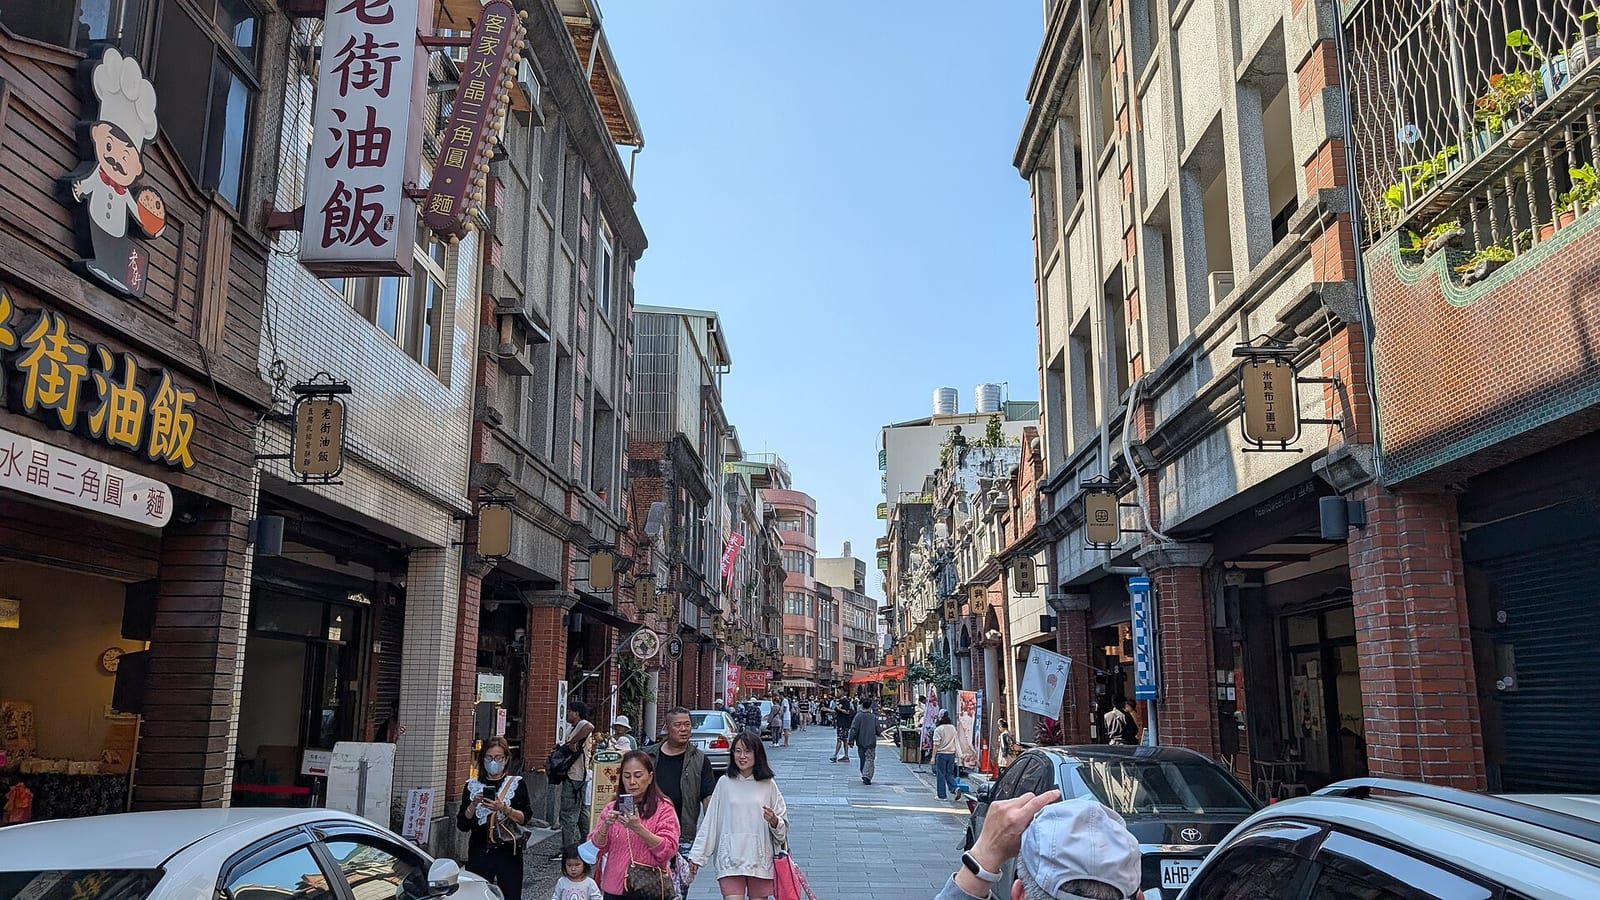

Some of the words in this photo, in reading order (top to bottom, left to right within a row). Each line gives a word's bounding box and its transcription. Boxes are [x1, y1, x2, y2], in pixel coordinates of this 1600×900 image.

[0, 293, 196, 469] 街油飯
[317, 408, 332, 462] 老街油飯
[1164, 866, 1199, 884] AHB-
